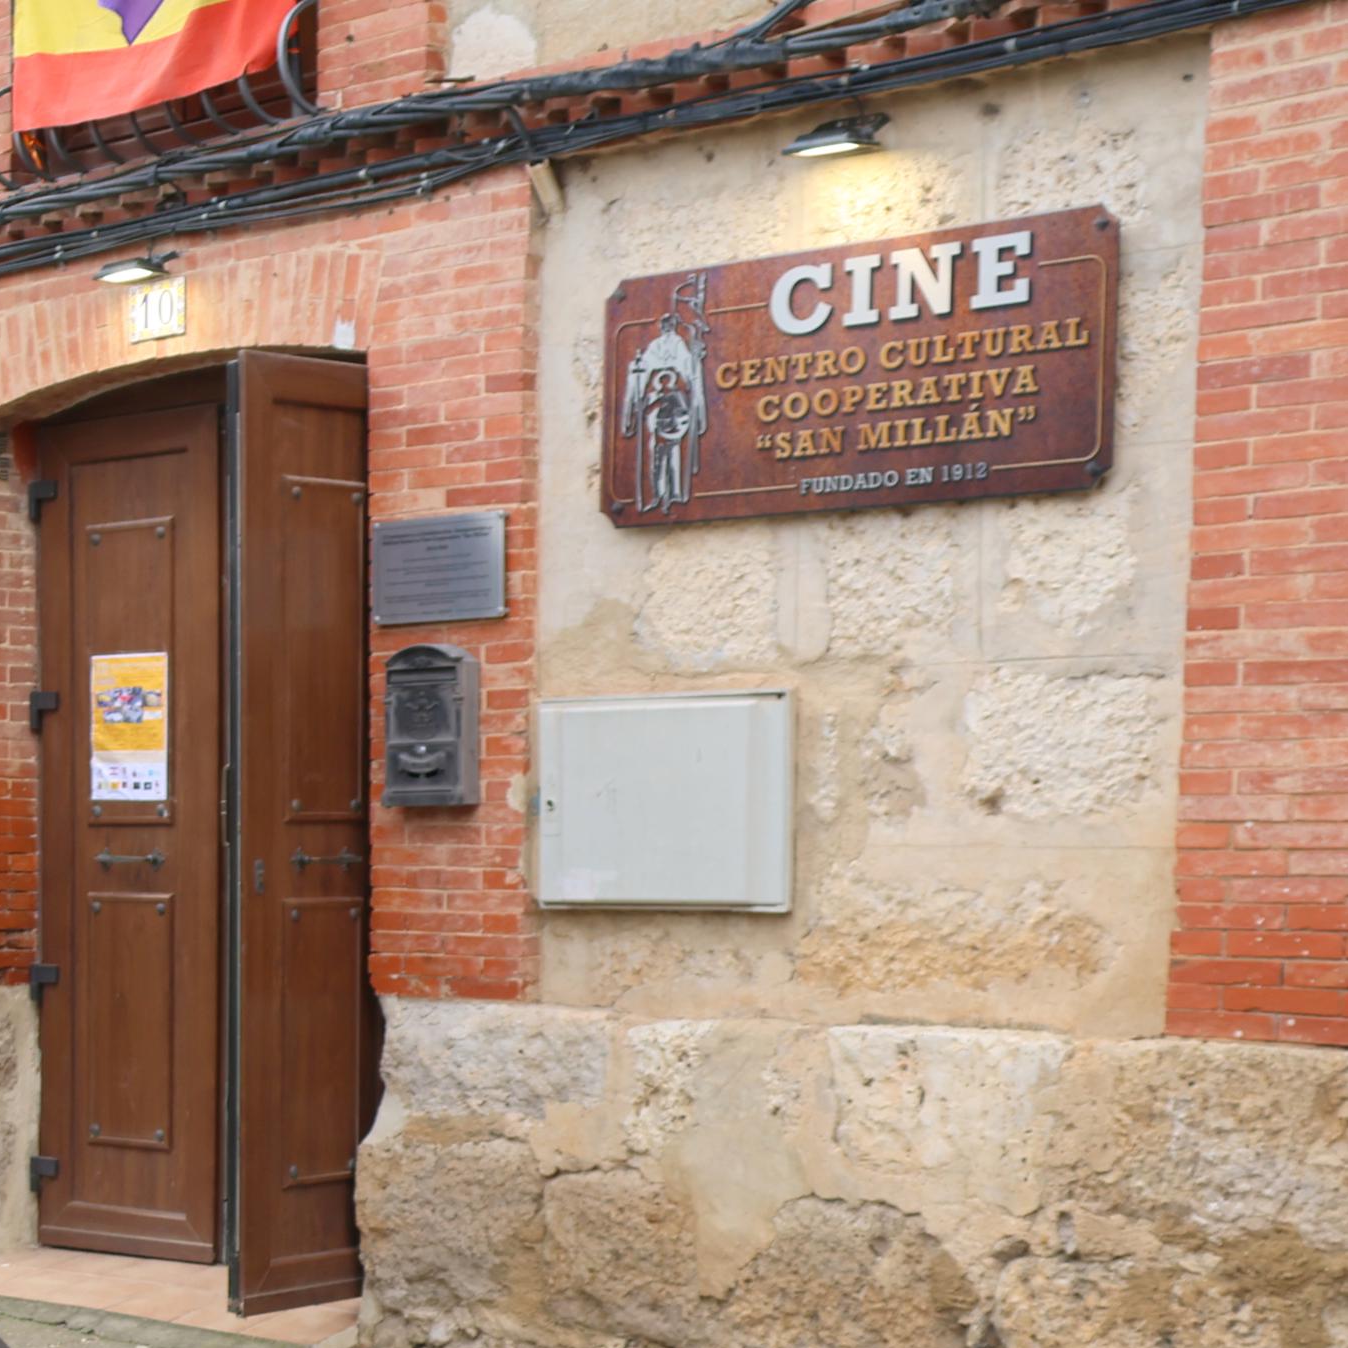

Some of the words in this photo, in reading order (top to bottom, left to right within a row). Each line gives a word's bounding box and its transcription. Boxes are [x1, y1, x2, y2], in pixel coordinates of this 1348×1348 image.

[139, 289, 174, 329] 10
[768, 230, 1033, 336] CINE
[715, 345, 867, 391] CENTRO
[879, 316, 1091, 372] CULTURAL
[756, 363, 1040, 424] COOPERATIVA
[799, 470, 899, 495] FUNDADO
[905, 466, 934, 486] EN
[941, 461, 989, 482] 1912
